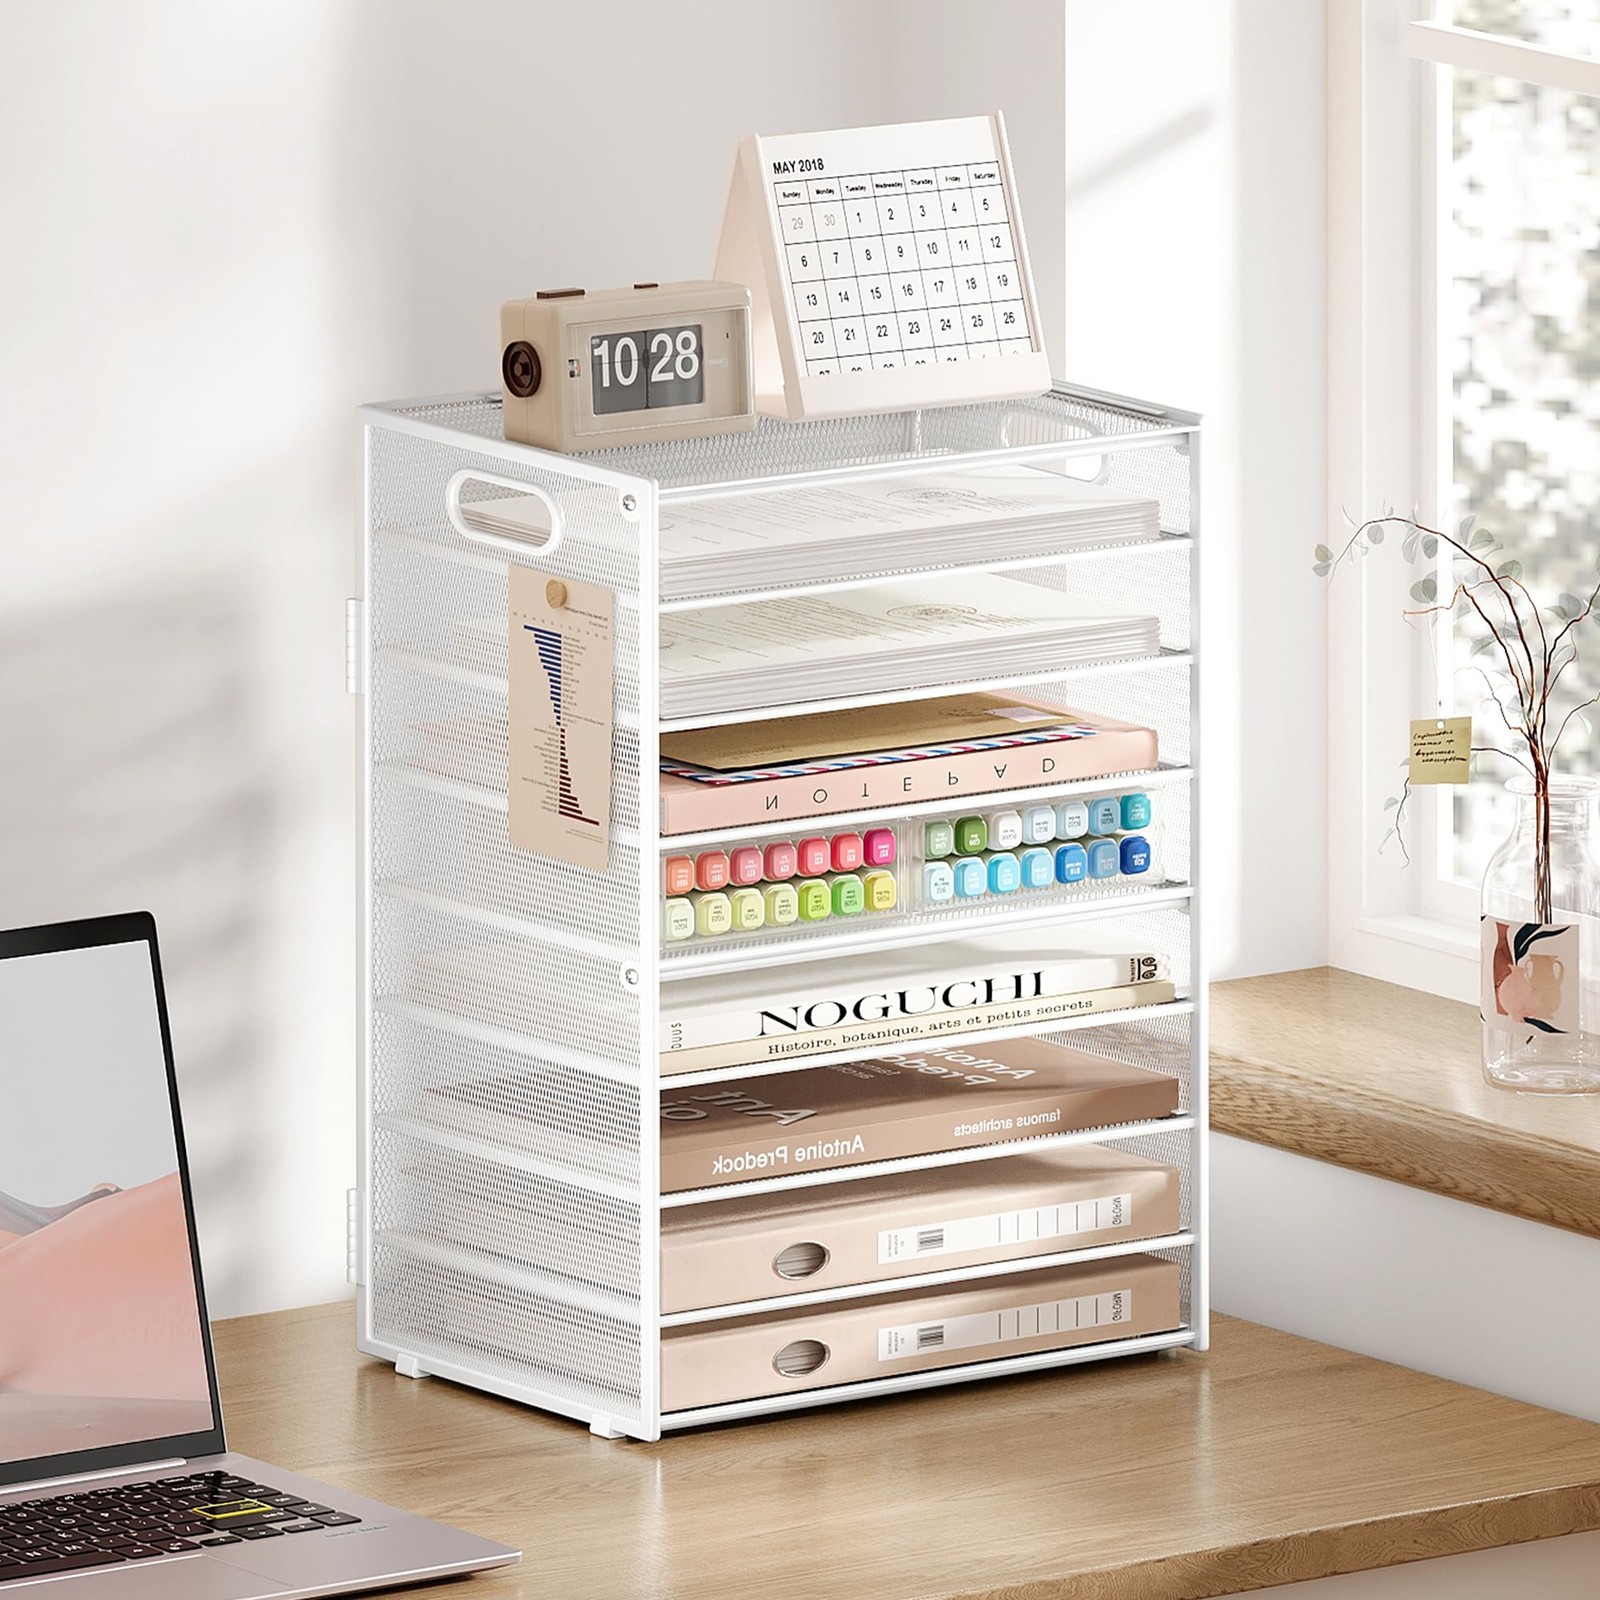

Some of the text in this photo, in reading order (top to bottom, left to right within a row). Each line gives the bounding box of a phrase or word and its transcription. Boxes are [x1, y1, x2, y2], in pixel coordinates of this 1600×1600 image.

[773, 158, 824, 174] MAY 2018
[782, 191, 801, 199] Sunday
[792, 199, 989, 230] 29 30 1 2 3 4 5
[801, 236, 1001, 267] 6 7 8 9 10 11 12
[807, 275, 1008, 306] 13 14 15 16 17 18 19
[813, 312, 1015, 344] 20 21 22 23 24 25 26
[593, 330, 700, 388] 10 28
[757, 970, 1045, 1037] NOGUCHI
[768, 999, 1093, 1055] Histoire, botanique, arts et petits secrets
